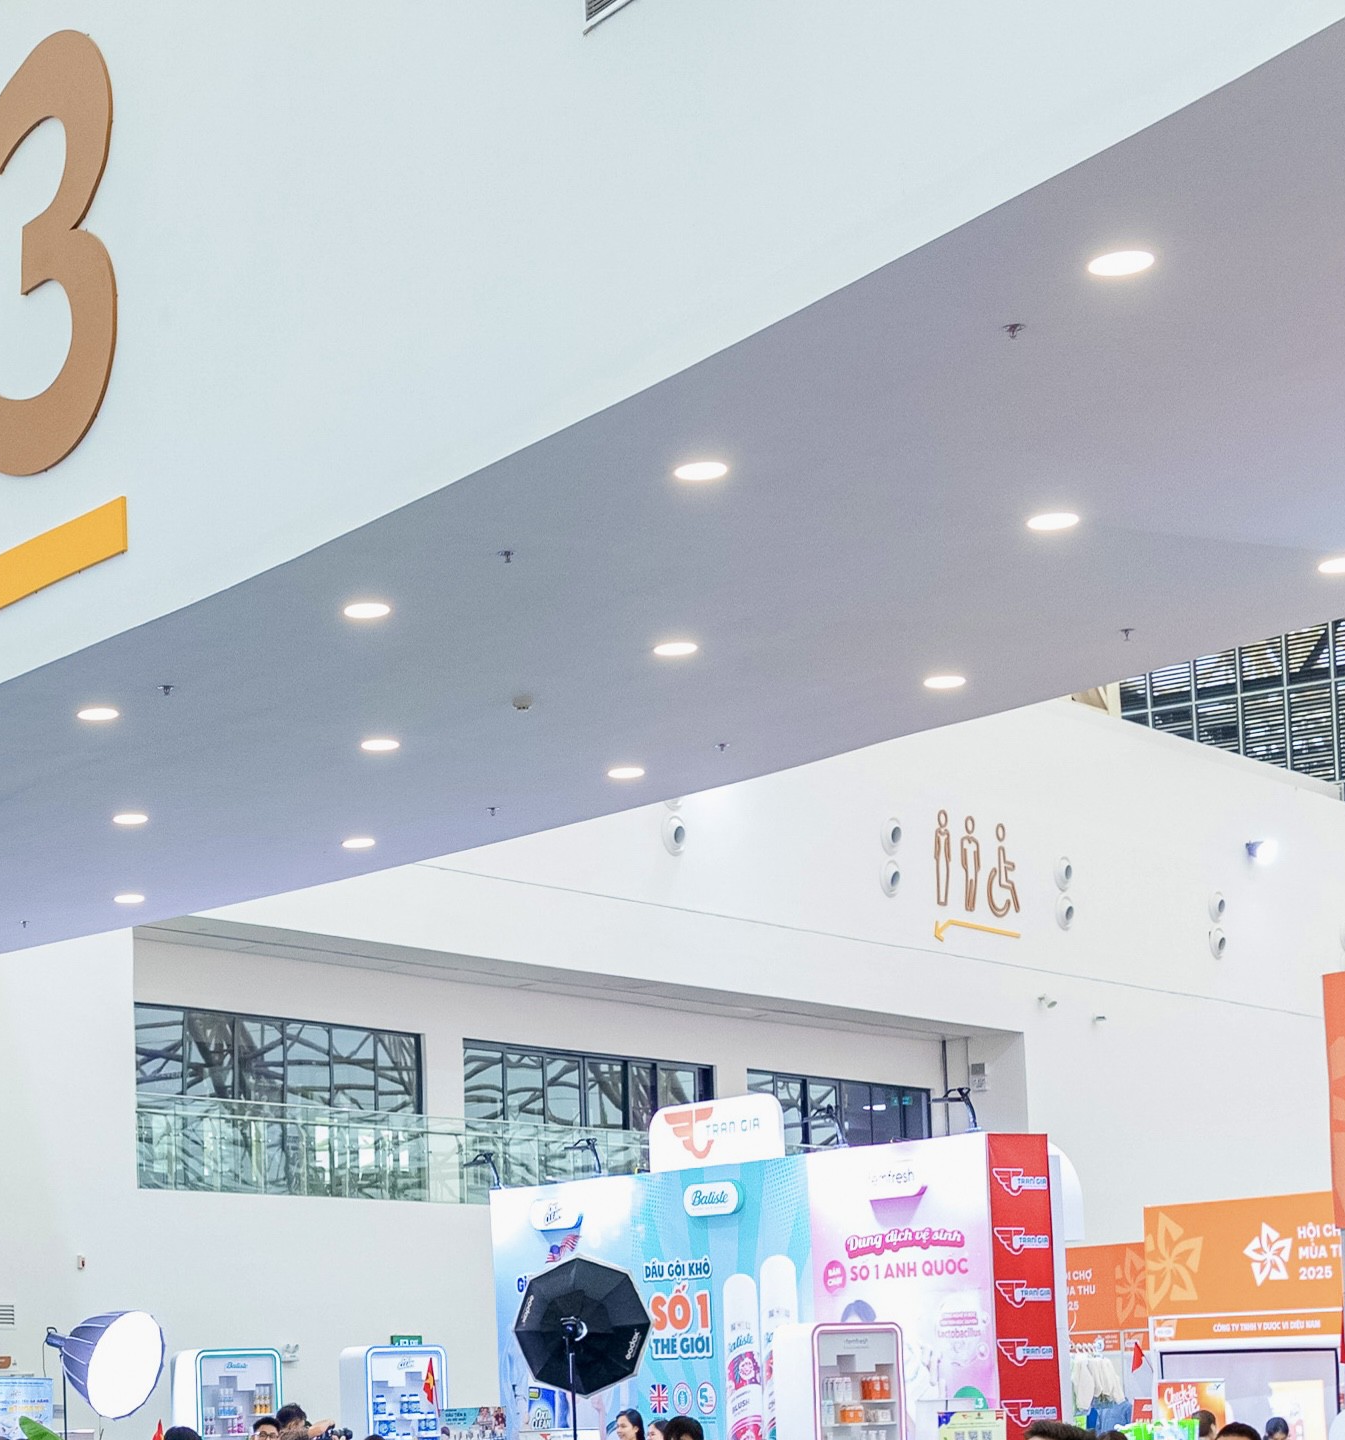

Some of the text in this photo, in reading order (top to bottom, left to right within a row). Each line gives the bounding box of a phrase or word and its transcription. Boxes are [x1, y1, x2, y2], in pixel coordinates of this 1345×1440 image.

[848, 1228, 961, 1251] Dung dịch vệ sinh
[1297, 1222, 1342, 1242] HỘI CH
[1298, 1242, 1328, 1260] MÙA
[667, 1260, 685, 1281] GỘI
[688, 1258, 710, 1276] KHÔ
[874, 1264, 879, 1280] 1
[884, 1261, 917, 1279] ANH
[1072, 1268, 1093, 1282] CHỢ
[1299, 1266, 1332, 1280] 2025
[1077, 1285, 1096, 1295] THU
[651, 1285, 709, 1331] SỐ 1
[1231, 1323, 1239, 1331] TY
[653, 1334, 710, 1355] THẾ GIỚI
